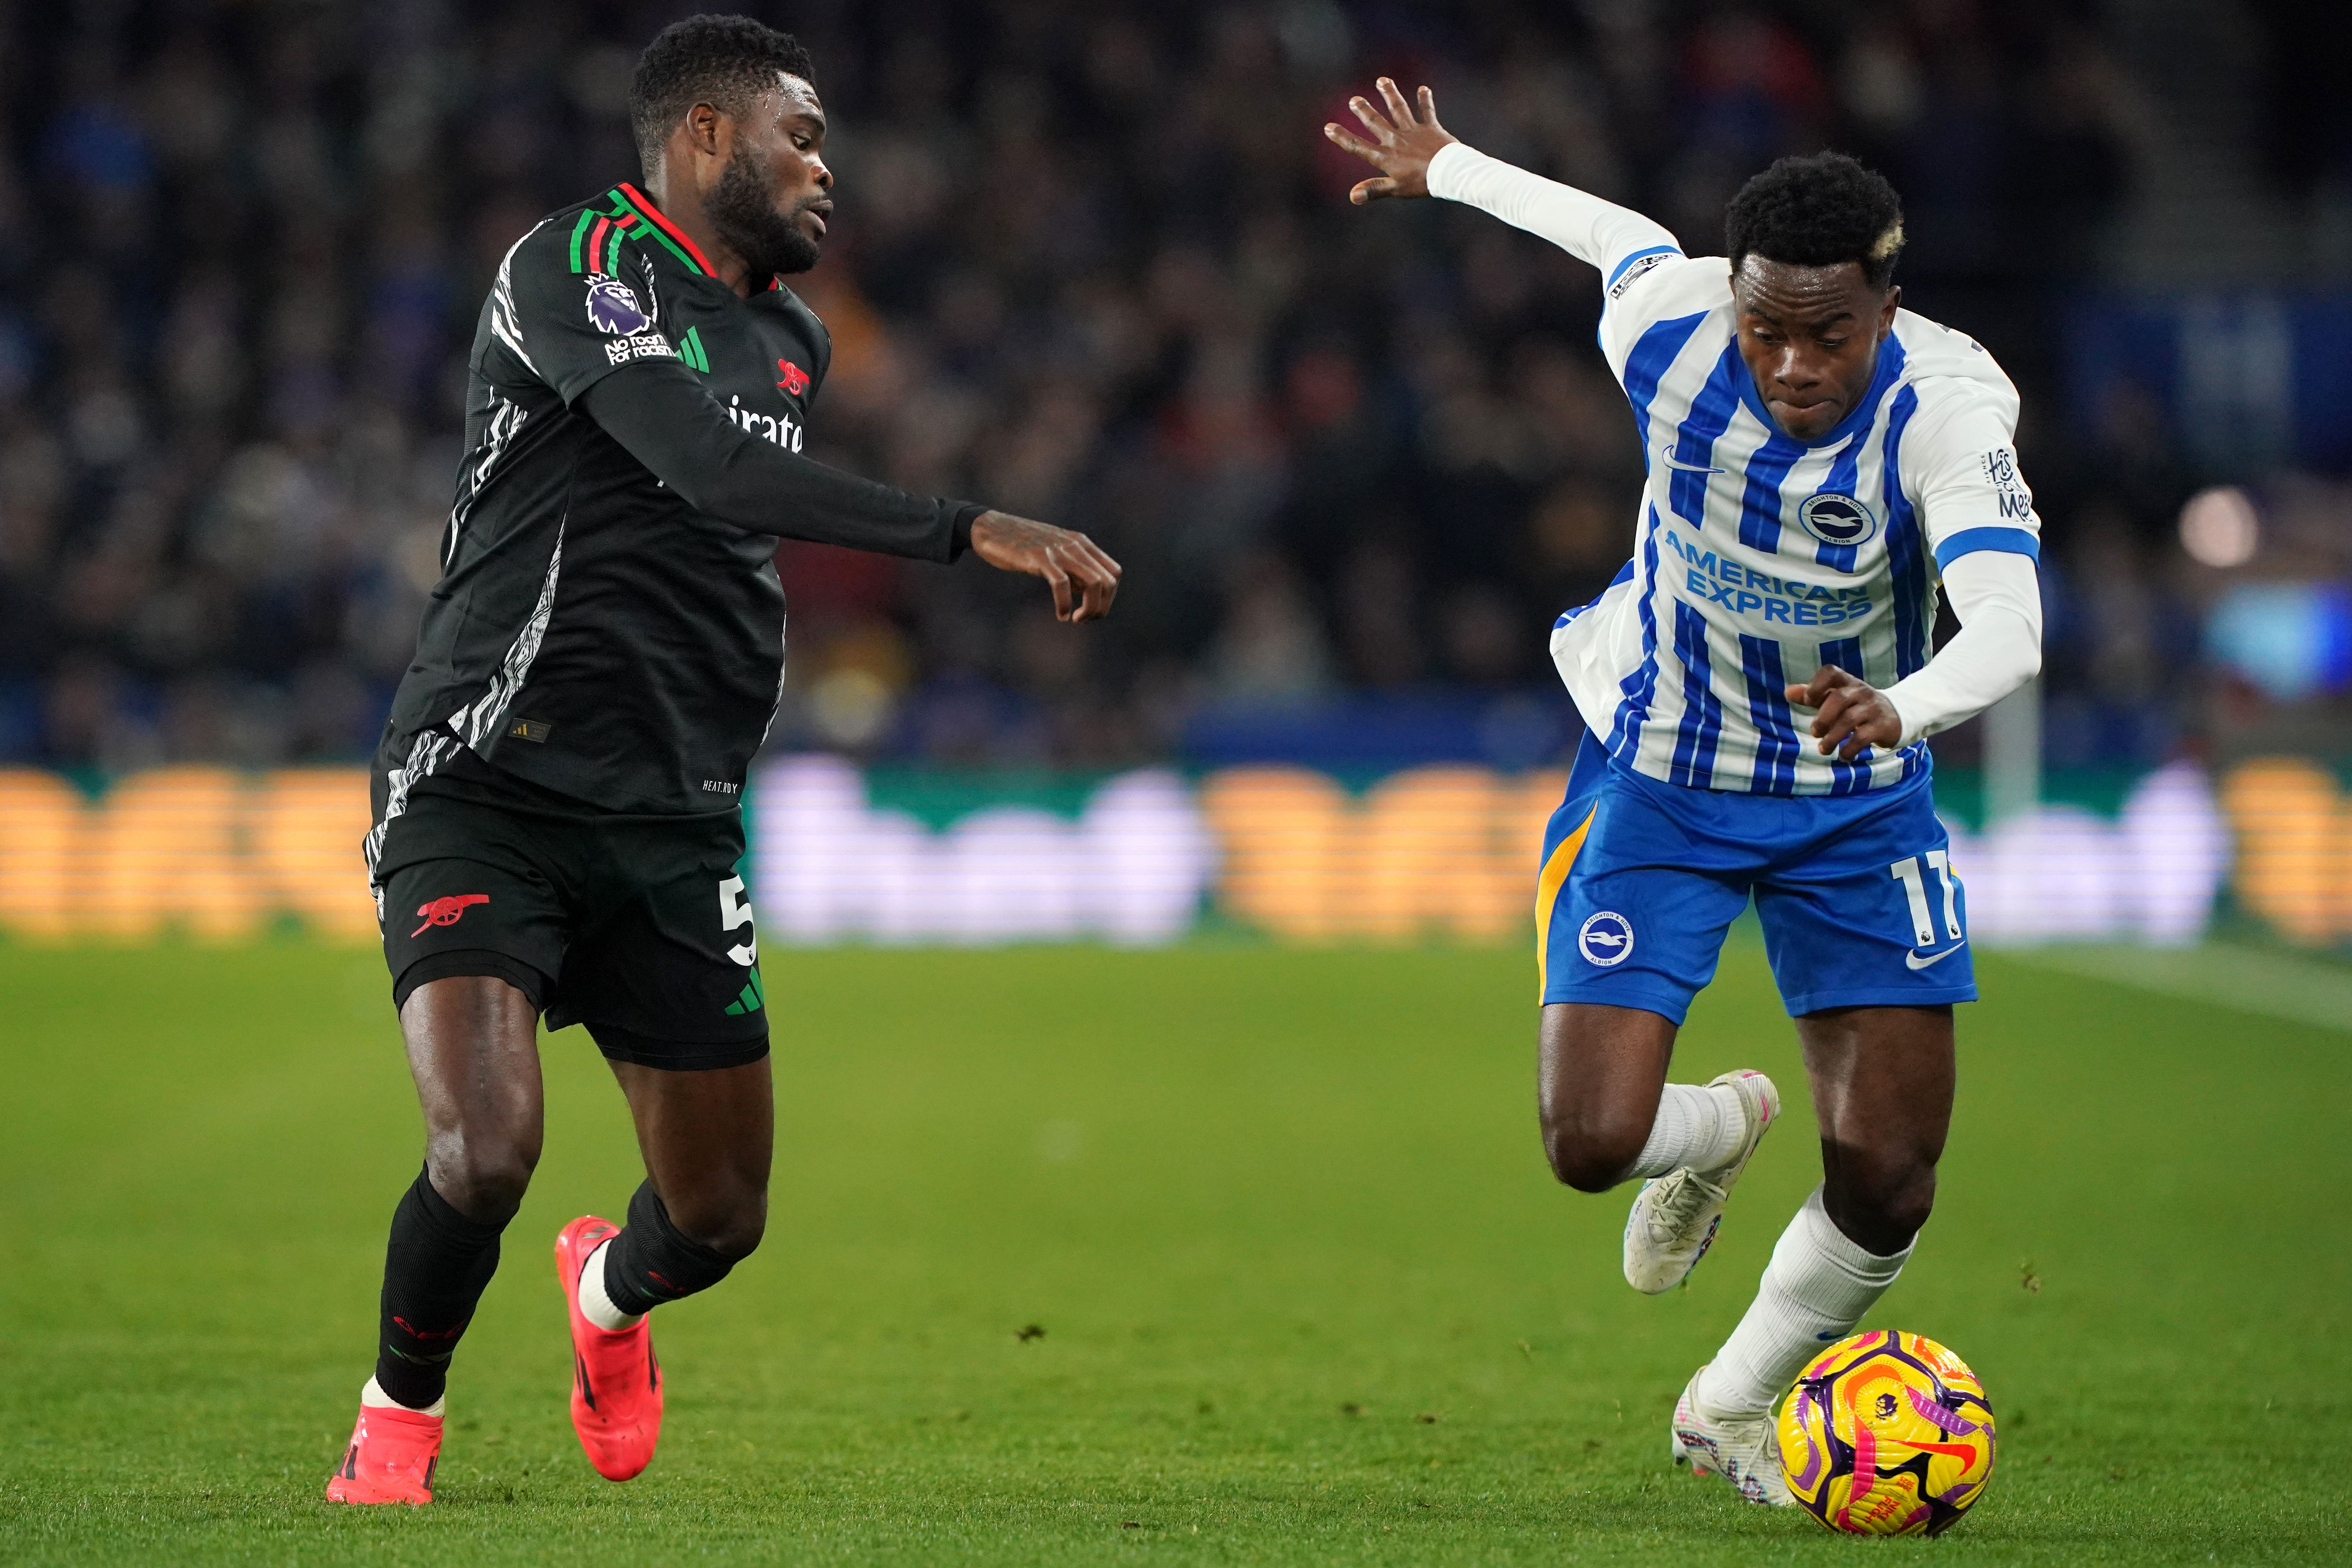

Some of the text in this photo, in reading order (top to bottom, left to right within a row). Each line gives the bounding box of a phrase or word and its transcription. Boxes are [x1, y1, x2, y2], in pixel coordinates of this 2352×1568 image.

[605, 334, 667, 356] No room
[633, 345, 676, 358] racism
[1807, 495, 1839, 507] BRIGHTON
[1848, 501, 1865, 513] HOVE
[1665, 530, 1867, 601] AMERICAN
[1687, 568, 1872, 625] EXPRESS
[702, 780, 737, 794] HEAT.RDY
[1890, 850, 1962, 947] 11
[719, 874, 757, 966] 5
[1587, 913, 1614, 925] BRIGHTON
[1620, 919, 1631, 932] HOVE
[1865, 1495, 1892, 1524] FLIGHT
[1877, 1501, 1901, 1521] NIKE
